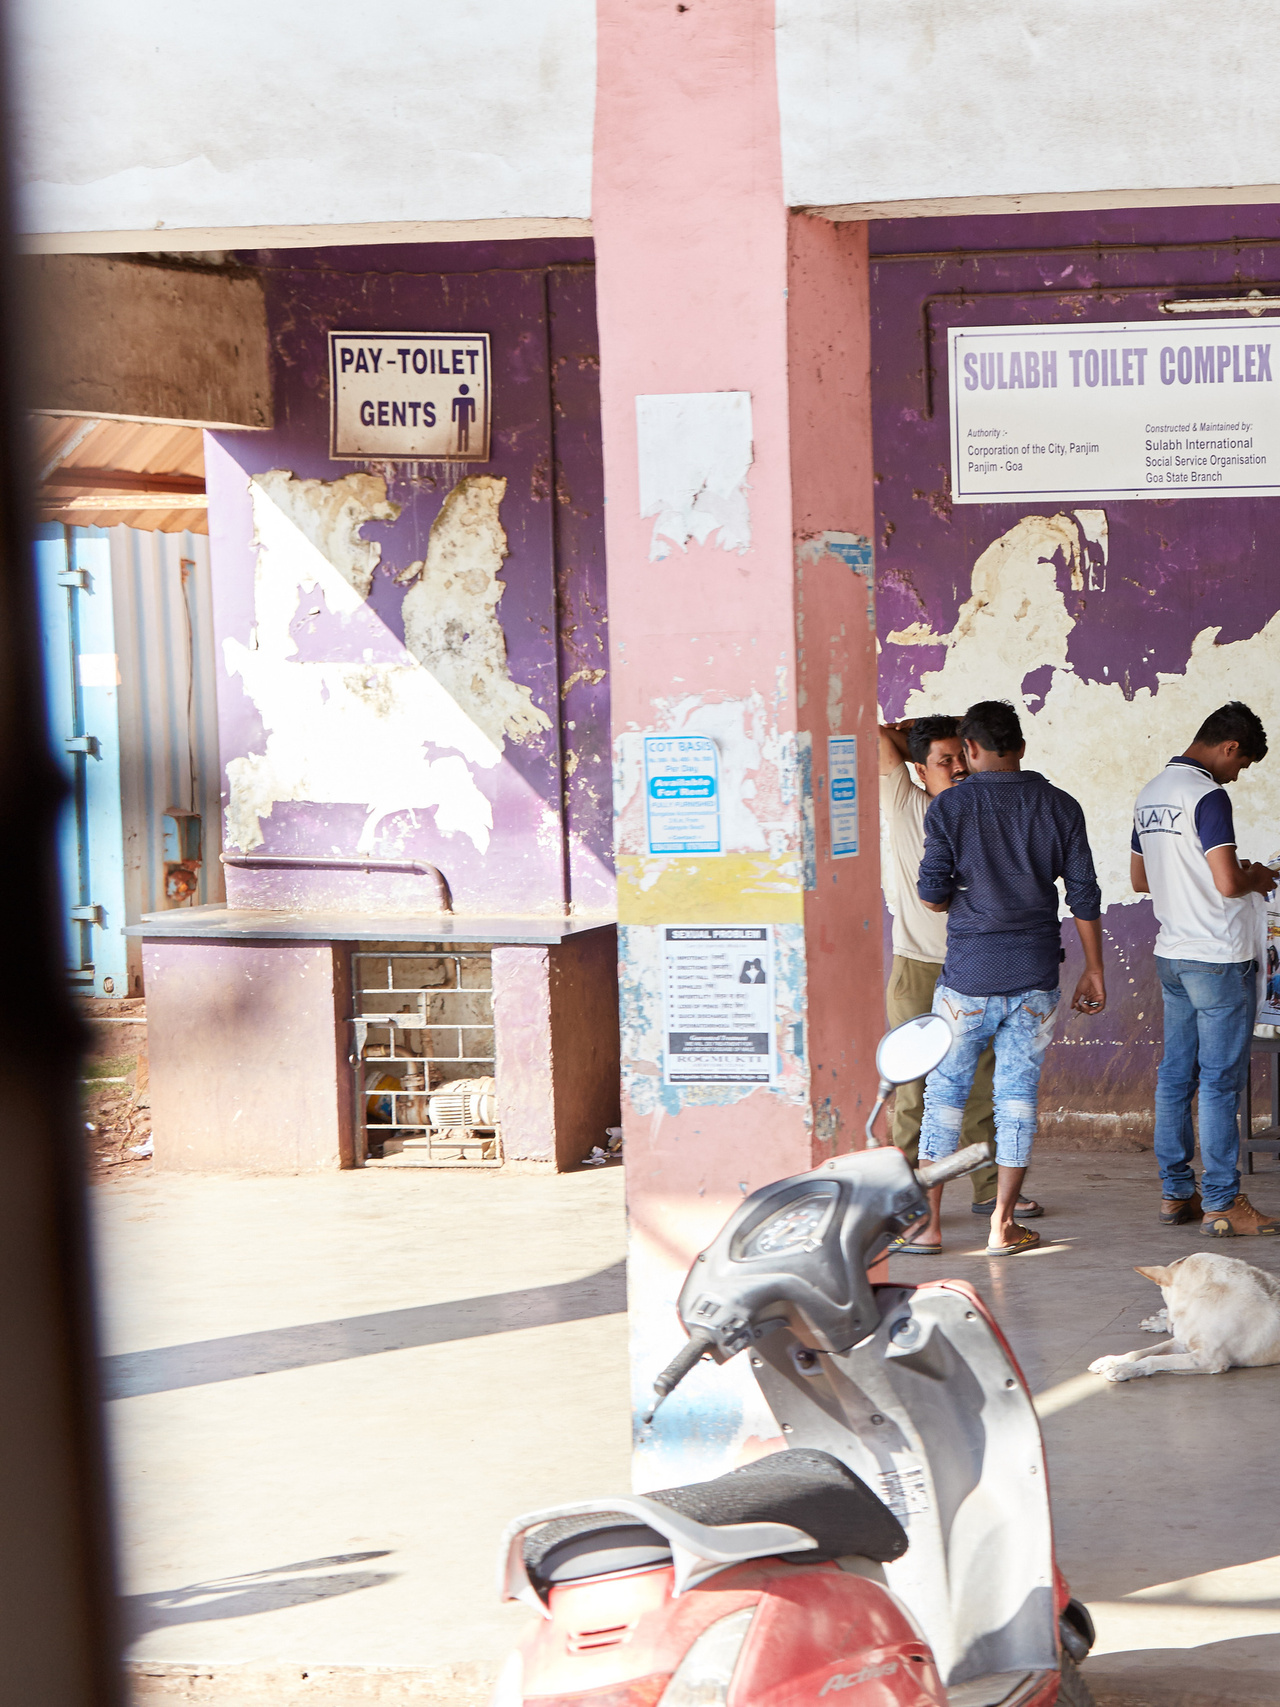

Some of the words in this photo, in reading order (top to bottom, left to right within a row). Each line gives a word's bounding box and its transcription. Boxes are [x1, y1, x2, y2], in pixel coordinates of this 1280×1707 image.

[963, 351, 1058, 391] SULABH
[1069, 348, 1148, 388] TOILET
[1159, 343, 1273, 385] COMPLEX
[360, 400, 436, 428] GENTS
[1145, 423, 1190, 433] Constructed
[1192, 423, 1197, 432] &
[1199, 421, 1240, 432] Maintained
[1241, 421, 1253, 432] by:
[967, 444, 1019, 457] Corporation
[1021, 444, 1031, 454] of
[1032, 444, 1046, 454] the
[1048, 443, 1067, 456] City,
[1069, 442, 1099, 455] Panjim
[1145, 439, 1182, 451] Sulabh
[1186, 437, 1253, 450] International
[1145, 456, 1172, 467] Social
[1175, 455, 1207, 466] Service
[1210, 454, 1266, 467] Organisation
[968, 461, 998, 474] Panjim
[1005, 461, 1023, 472] Goa
[1146, 472, 1163, 483] Goa
[1166, 471, 1188, 482] State
[1191, 471, 1222, 482] Branch
[649, 742, 672, 752] COT
[657, 788, 678, 797] For
